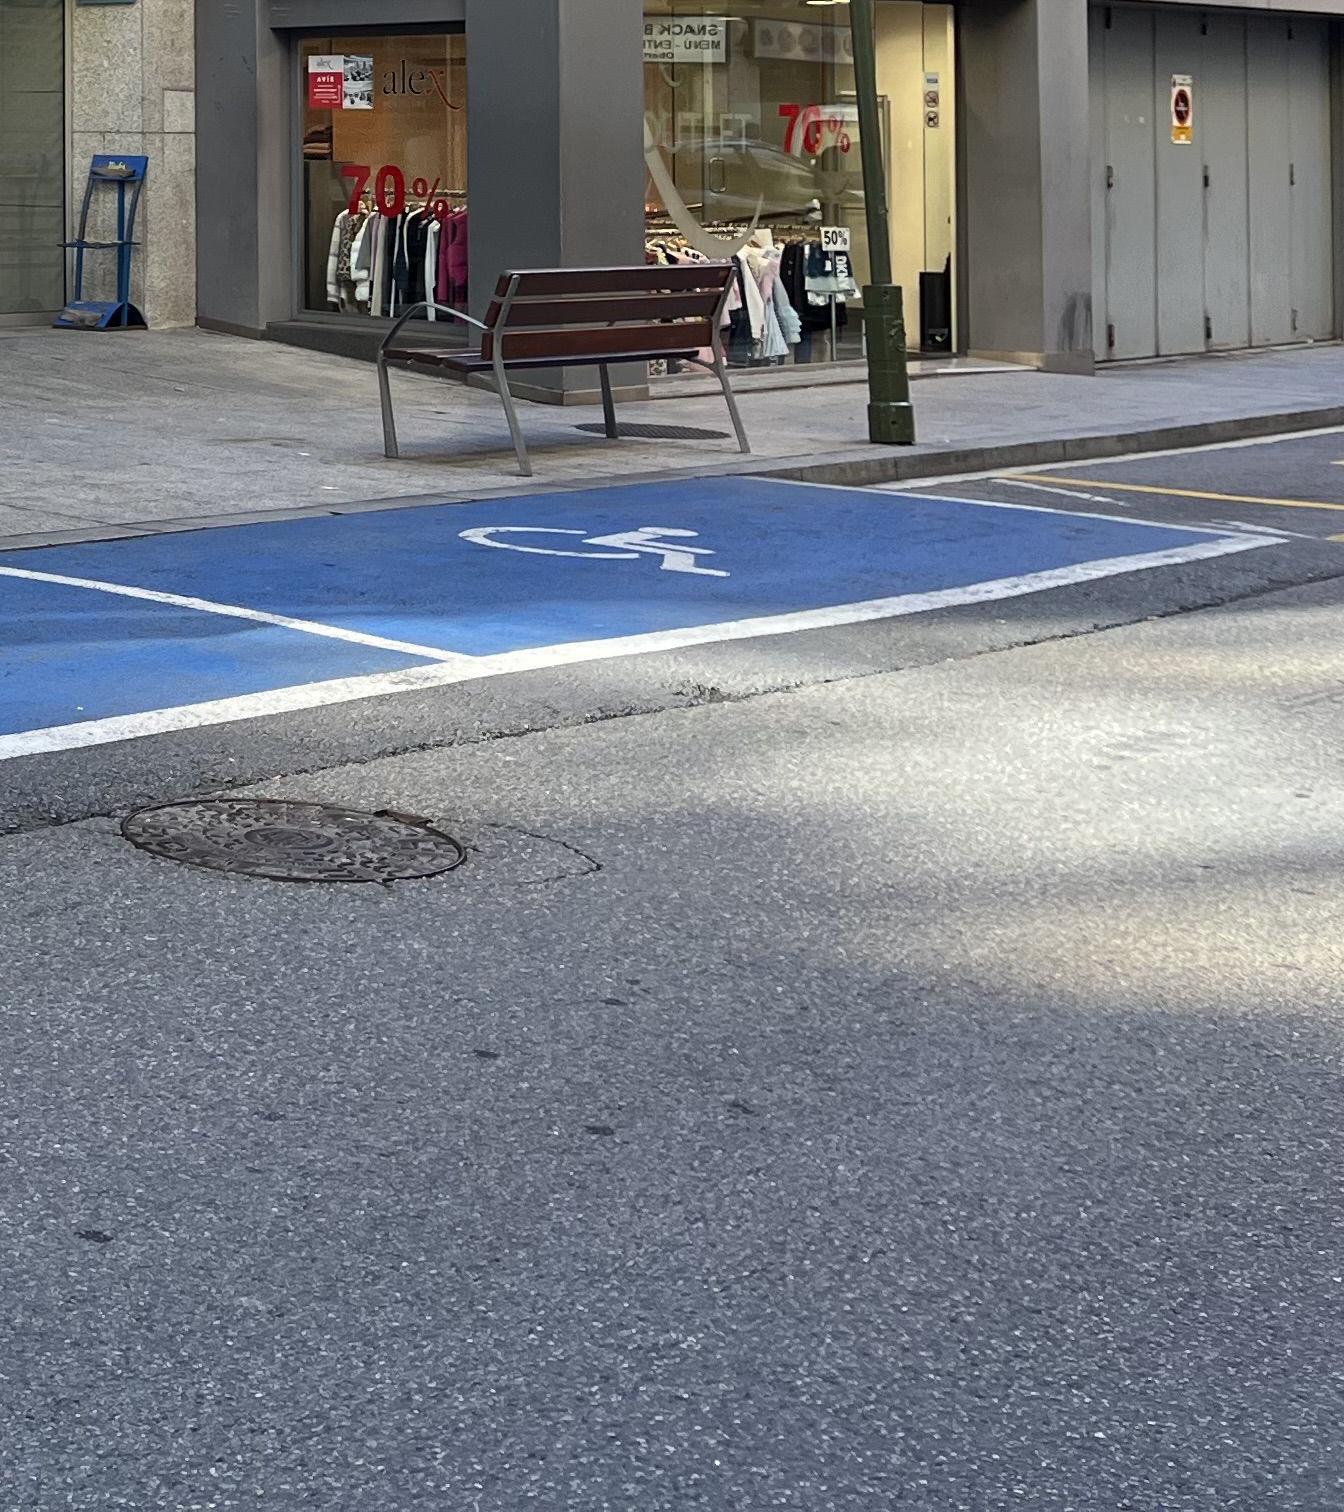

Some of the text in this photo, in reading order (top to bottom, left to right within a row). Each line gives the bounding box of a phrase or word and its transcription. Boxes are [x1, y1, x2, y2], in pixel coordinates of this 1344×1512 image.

[383, 60, 464, 110] alex
[778, 104, 851, 154] 70%
[340, 164, 449, 220] 70%
[823, 230, 848, 245] 50%
